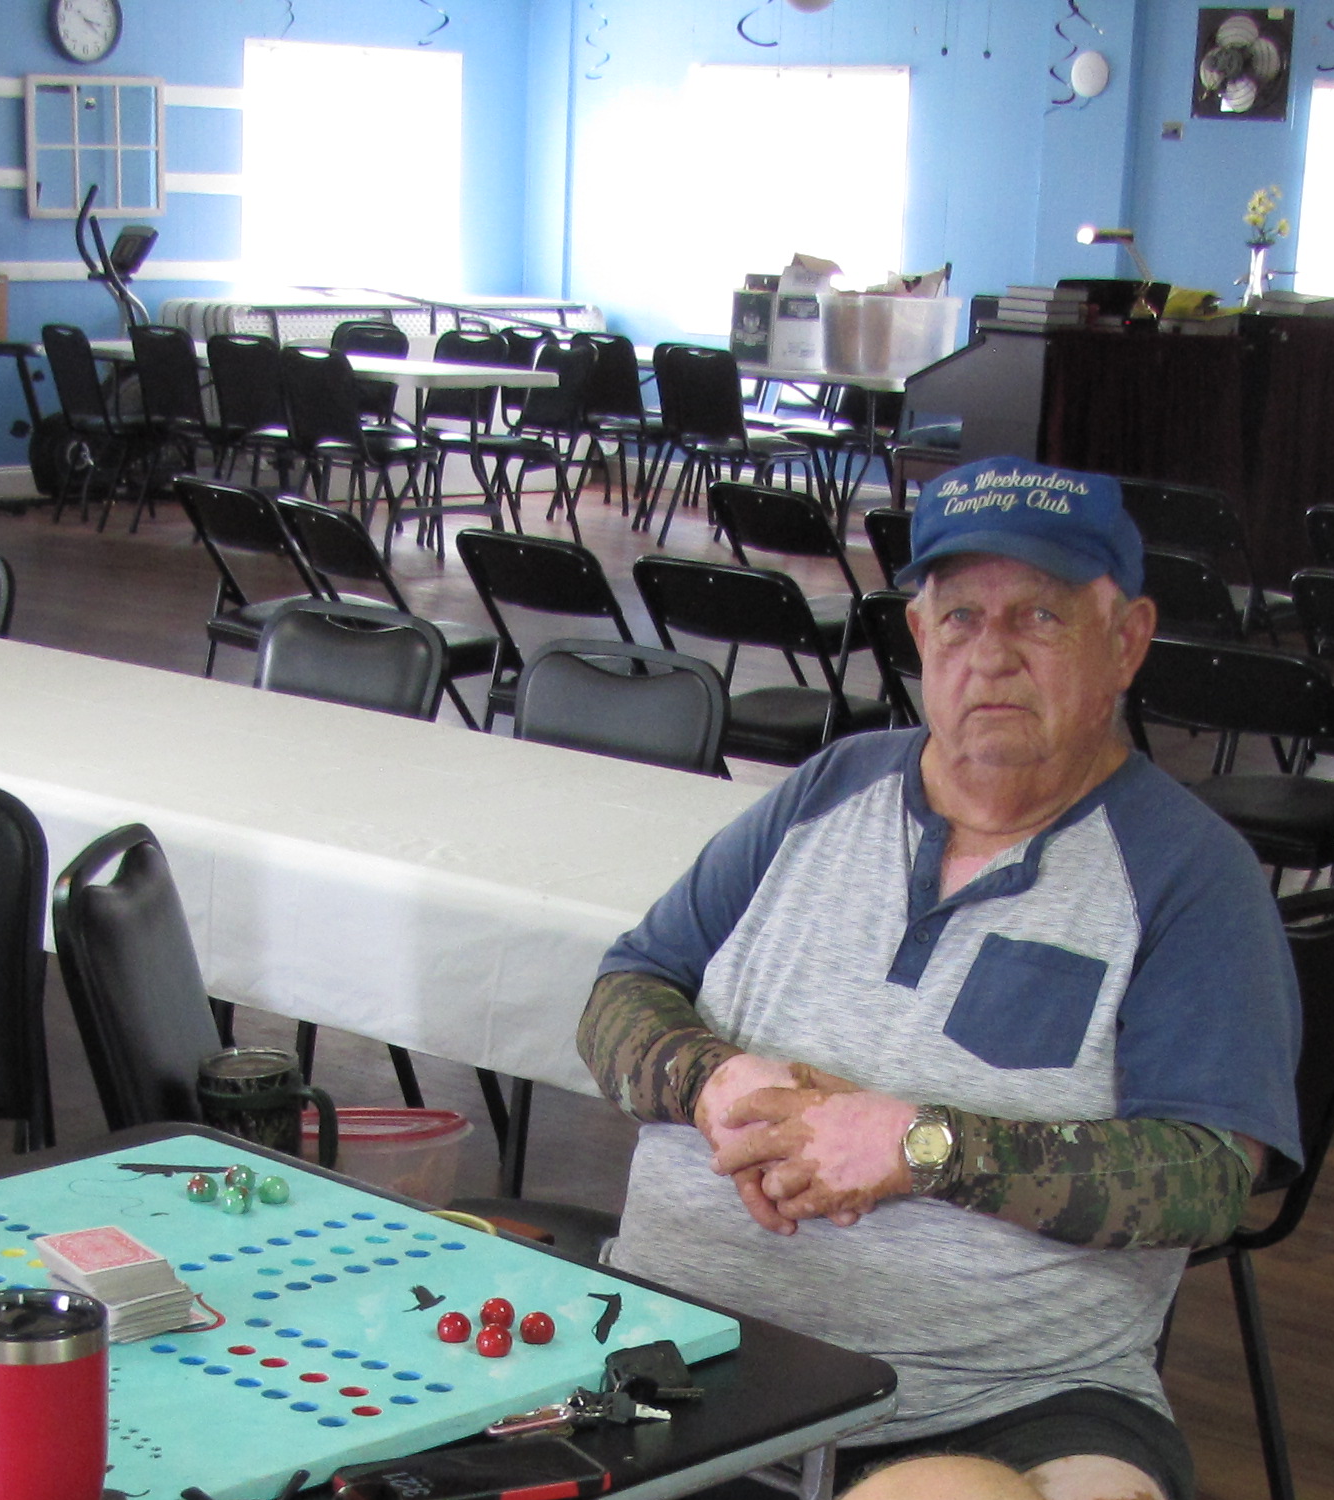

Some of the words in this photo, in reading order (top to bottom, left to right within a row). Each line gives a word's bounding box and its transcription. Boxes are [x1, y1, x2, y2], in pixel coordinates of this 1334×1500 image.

[937, 480, 969, 498] The
[974, 468, 1089, 495] Weekenders
[944, 491, 1018, 516] Camping
[1026, 489, 1071, 514] Club
